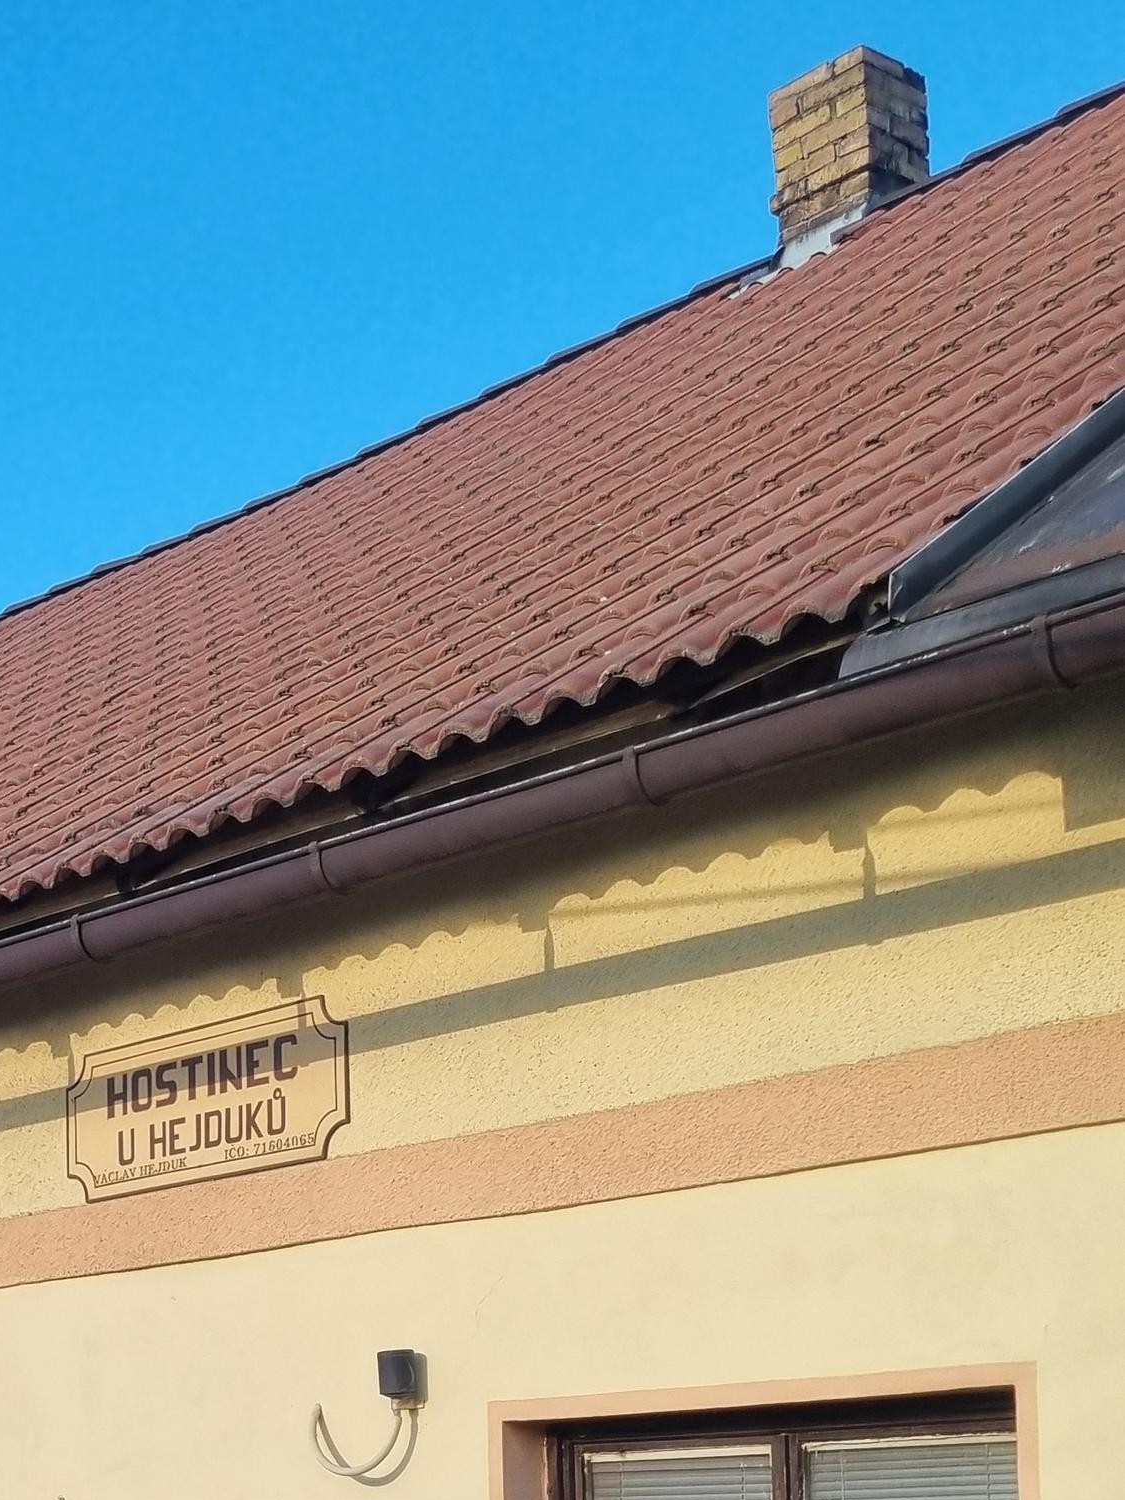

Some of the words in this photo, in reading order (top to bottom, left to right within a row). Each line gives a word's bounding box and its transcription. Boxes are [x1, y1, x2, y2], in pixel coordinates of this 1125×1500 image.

[107, 1034, 298, 1120] HOSTINEC
[94, 1167, 137, 1186] VÁCLAV
[138, 1157, 188, 1178] HEJDUK
[224, 1144, 250, 1160] IČO:
[118, 1128, 135, 1166] U
[149, 1087, 286, 1160] HEJDUKŮ
